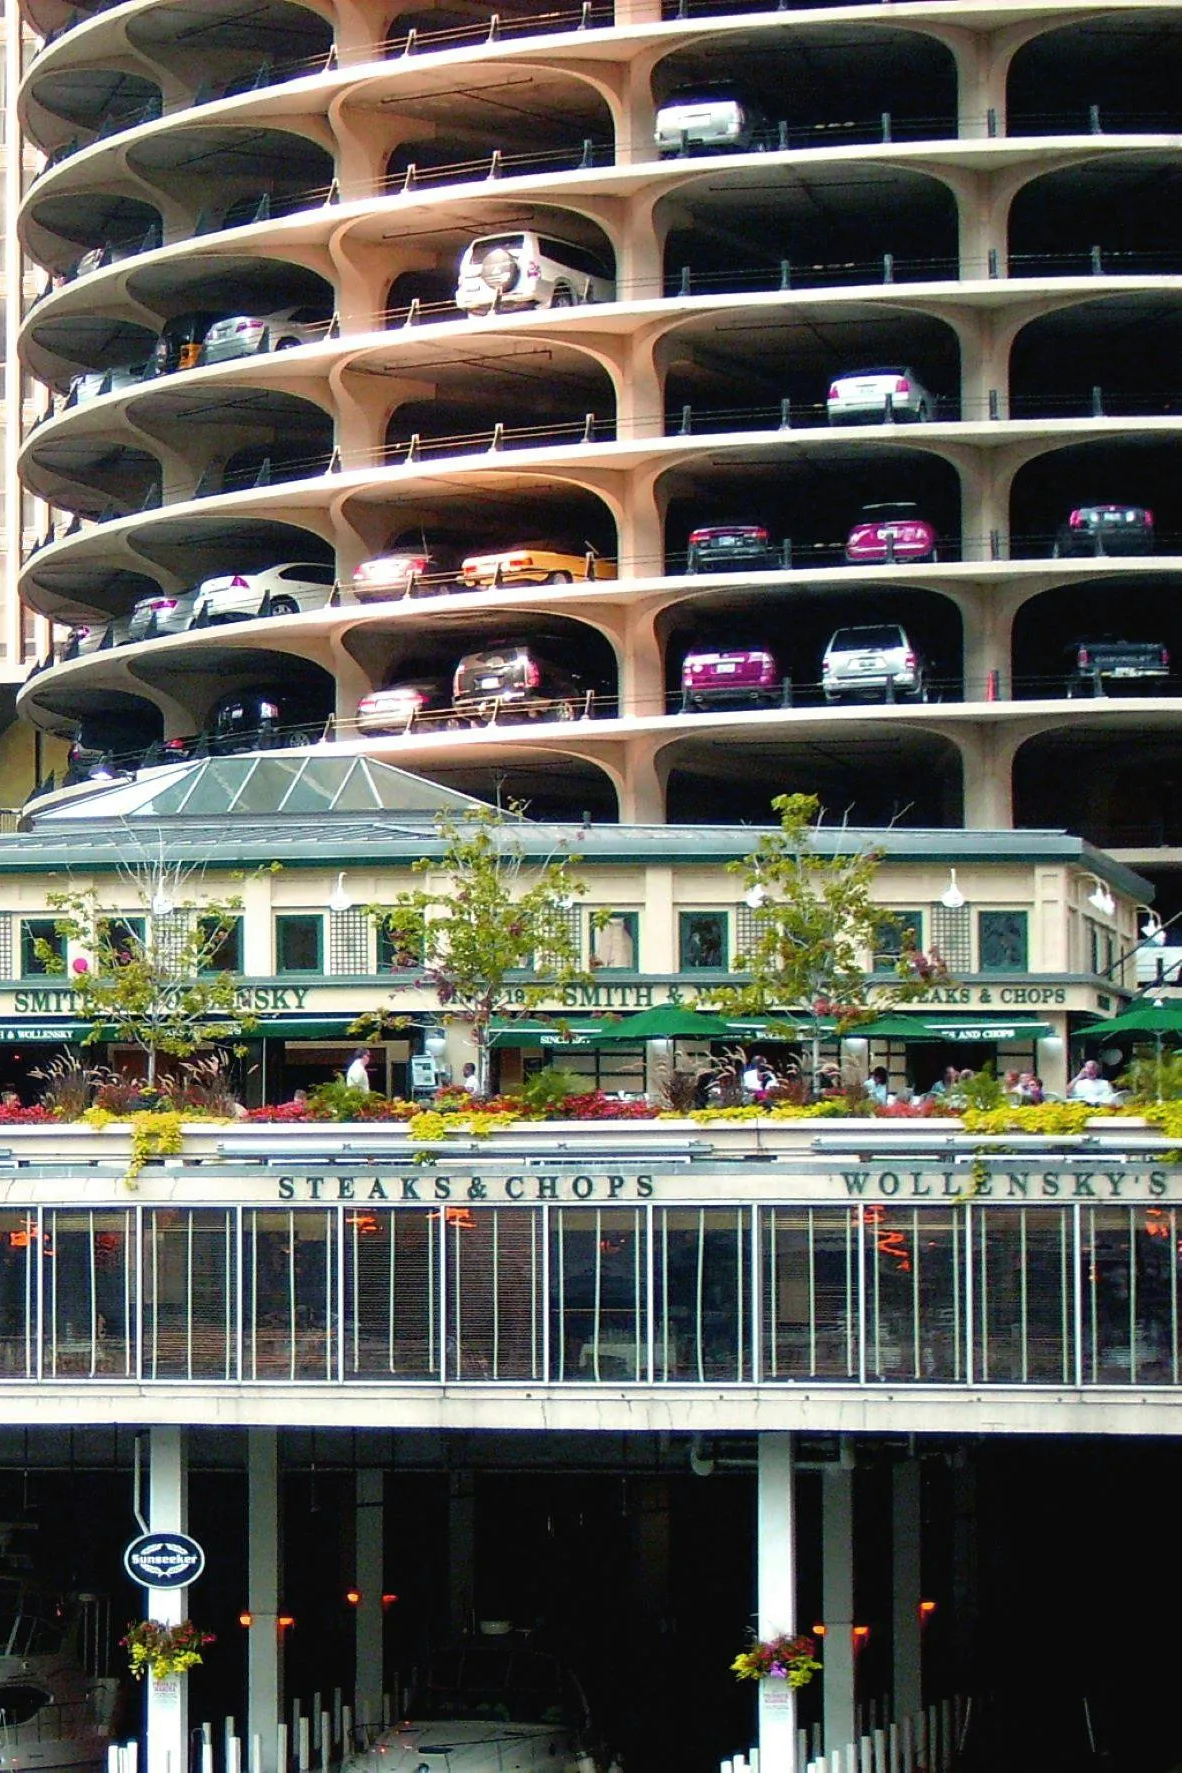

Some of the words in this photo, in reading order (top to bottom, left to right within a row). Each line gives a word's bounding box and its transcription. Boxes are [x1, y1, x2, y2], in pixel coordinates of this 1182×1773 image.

[562, 985, 654, 1007] SMITH
[665, 987, 684, 1006] &
[892, 988, 970, 1004] SEAKS
[979, 988, 992, 1004] &
[1000, 988, 1066, 1004] CHOPS
[7, 1030, 15, 1040] &
[17, 1029, 74, 1039] WOLLENSKY
[958, 1030, 981, 1040] AND
[982, 1029, 1015, 1039] CHOPS
[277, 1175, 450, 1200] STEAKS
[466, 1177, 487, 1200] &
[505, 1174, 654, 1199] CHOPS
[840, 1170, 1167, 1197] WOLLENSKY'S
[131, 1553, 198, 1565] Sunseeker
